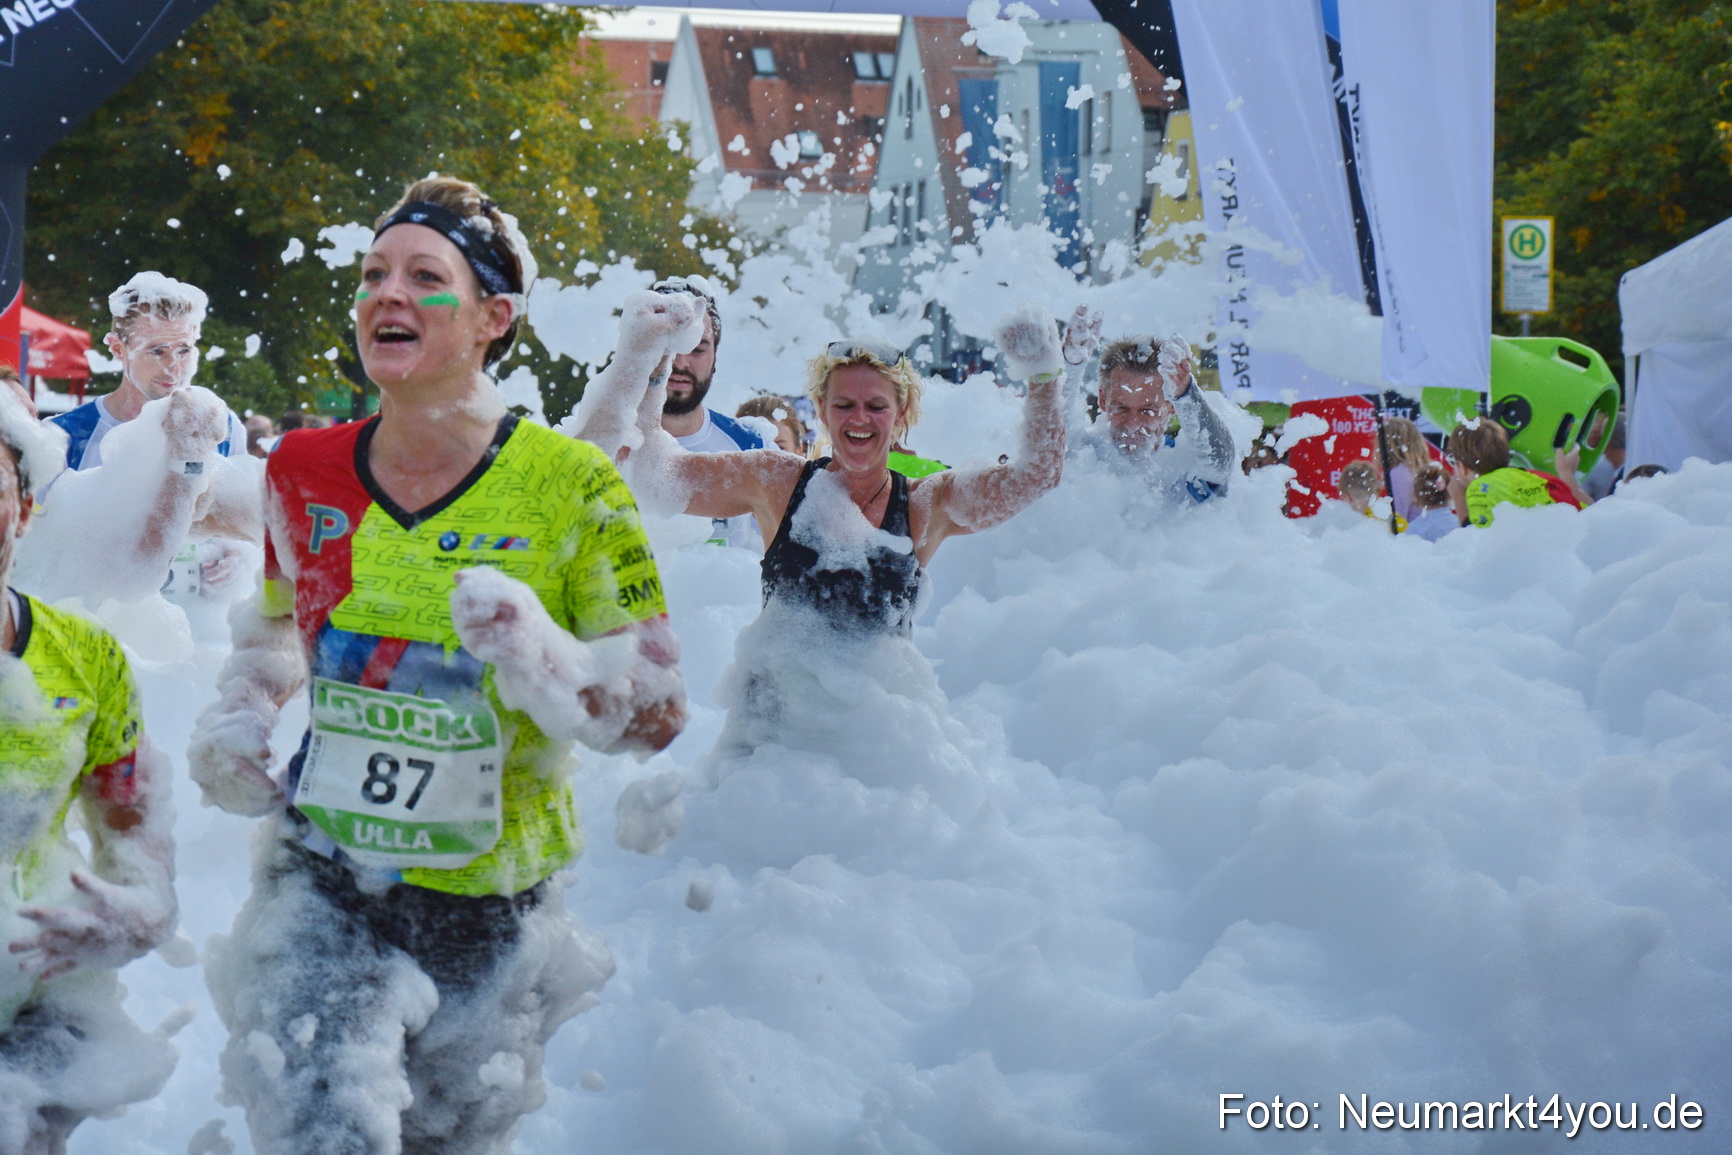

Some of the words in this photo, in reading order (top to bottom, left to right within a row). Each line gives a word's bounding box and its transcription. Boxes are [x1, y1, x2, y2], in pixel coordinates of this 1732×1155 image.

[1519, 232, 1536, 252] H
[1332, 419, 1352, 433] 100
[306, 503, 349, 554] P
[362, 752, 435, 811] 87
[354, 821, 434, 850] ULLA
